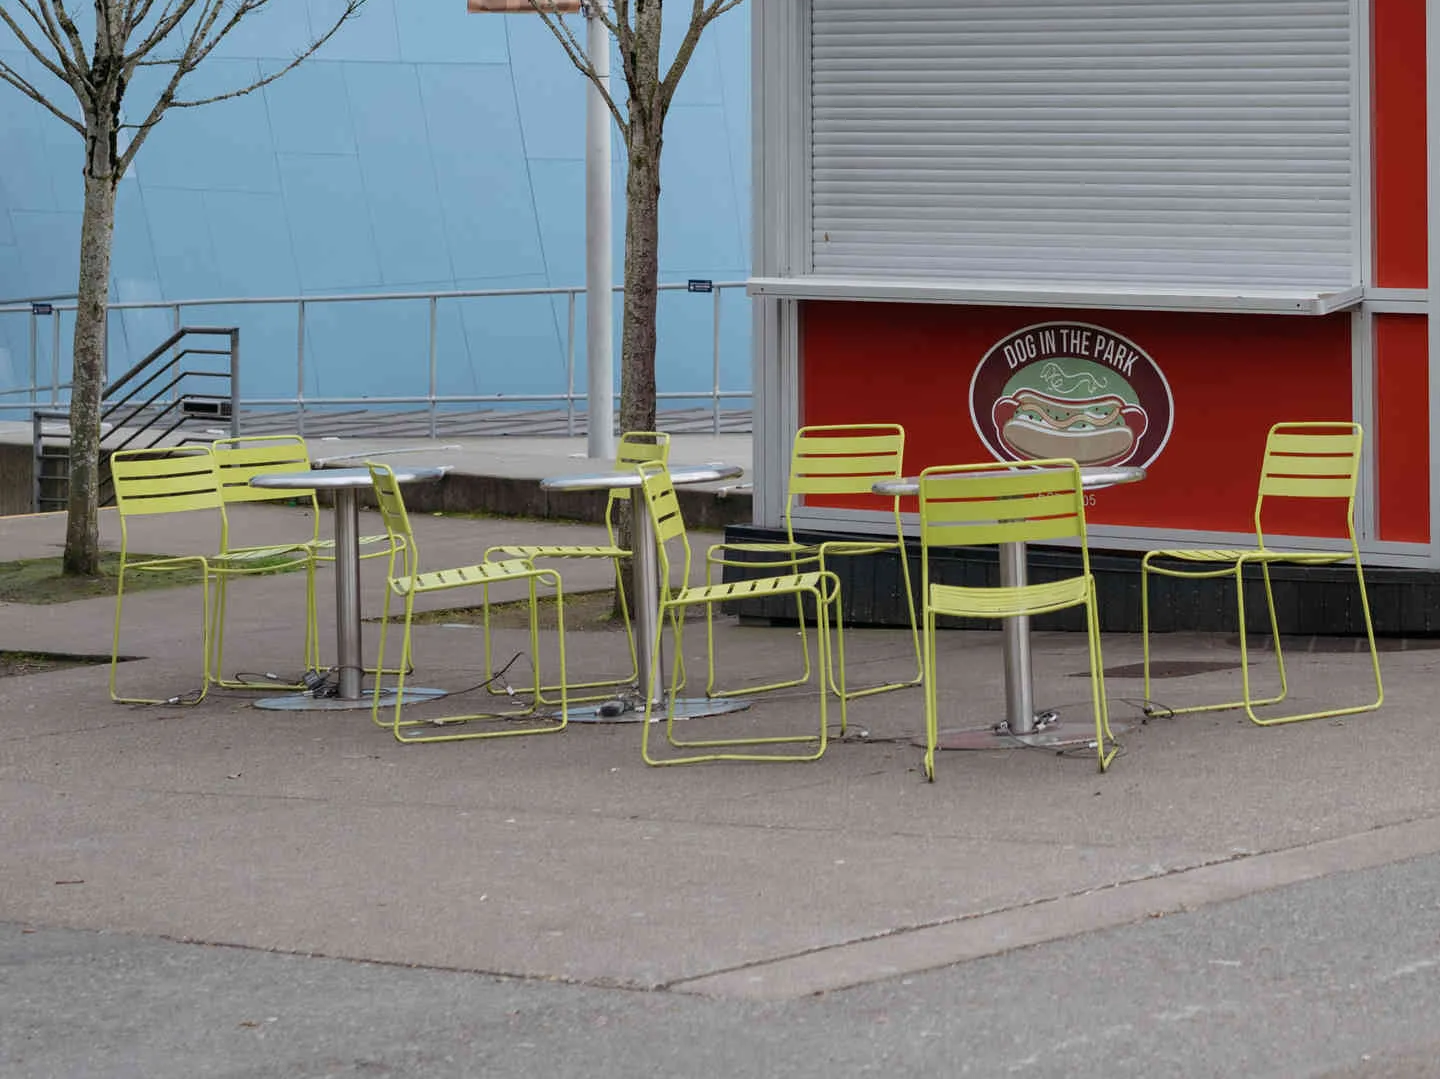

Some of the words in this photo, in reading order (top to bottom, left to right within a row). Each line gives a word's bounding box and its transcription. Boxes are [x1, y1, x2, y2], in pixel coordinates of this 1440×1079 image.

[1003, 334, 1037, 369] DOG
[1040, 329, 1056, 355] IN
[1060, 329, 1092, 356] THE
[1094, 335, 1139, 377] PARK
